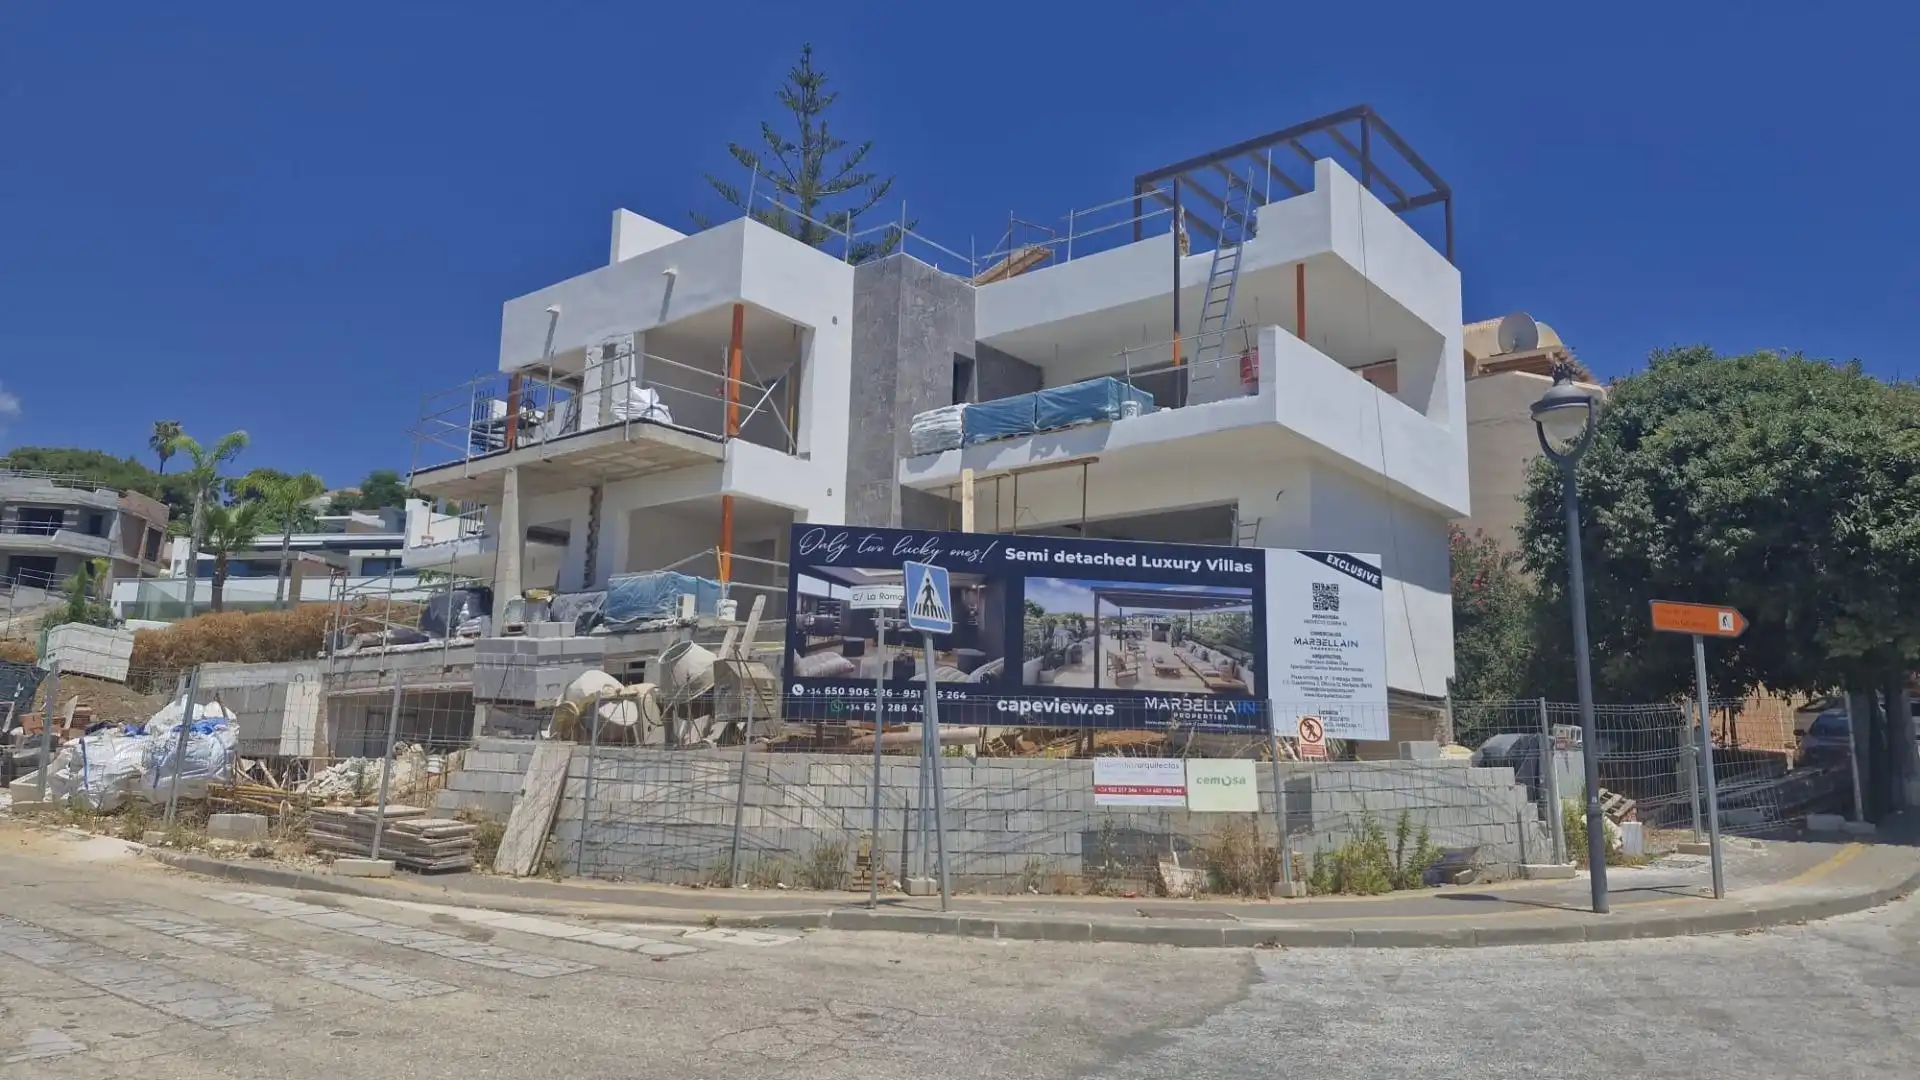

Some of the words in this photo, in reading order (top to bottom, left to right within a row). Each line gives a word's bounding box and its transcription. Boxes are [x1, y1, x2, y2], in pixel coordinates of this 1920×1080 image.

[799, 527, 851, 563] Only
[858, 533, 884, 554] two
[892, 535, 944, 564] lucky
[1005, 547, 1049, 562] Semi
[1054, 550, 1136, 567] detached
[1142, 555, 1201, 573] Luxury
[1206, 558, 1253, 573] Villas
[1326, 554, 1380, 585] EXCLUSIVE
[867, 592, 876, 600] La
[880, 592, 905, 601] Roma
[1293, 637, 1359, 648] MARBELLAIN
[824, 687, 845, 696] 650
[848, 687, 870, 697] 906
[903, 689, 921, 698] 951
[946, 691, 967, 699] 264
[864, 703, 884, 711] 62
[887, 703, 908, 712] 288
[996, 697, 1115, 716] capeview.es
